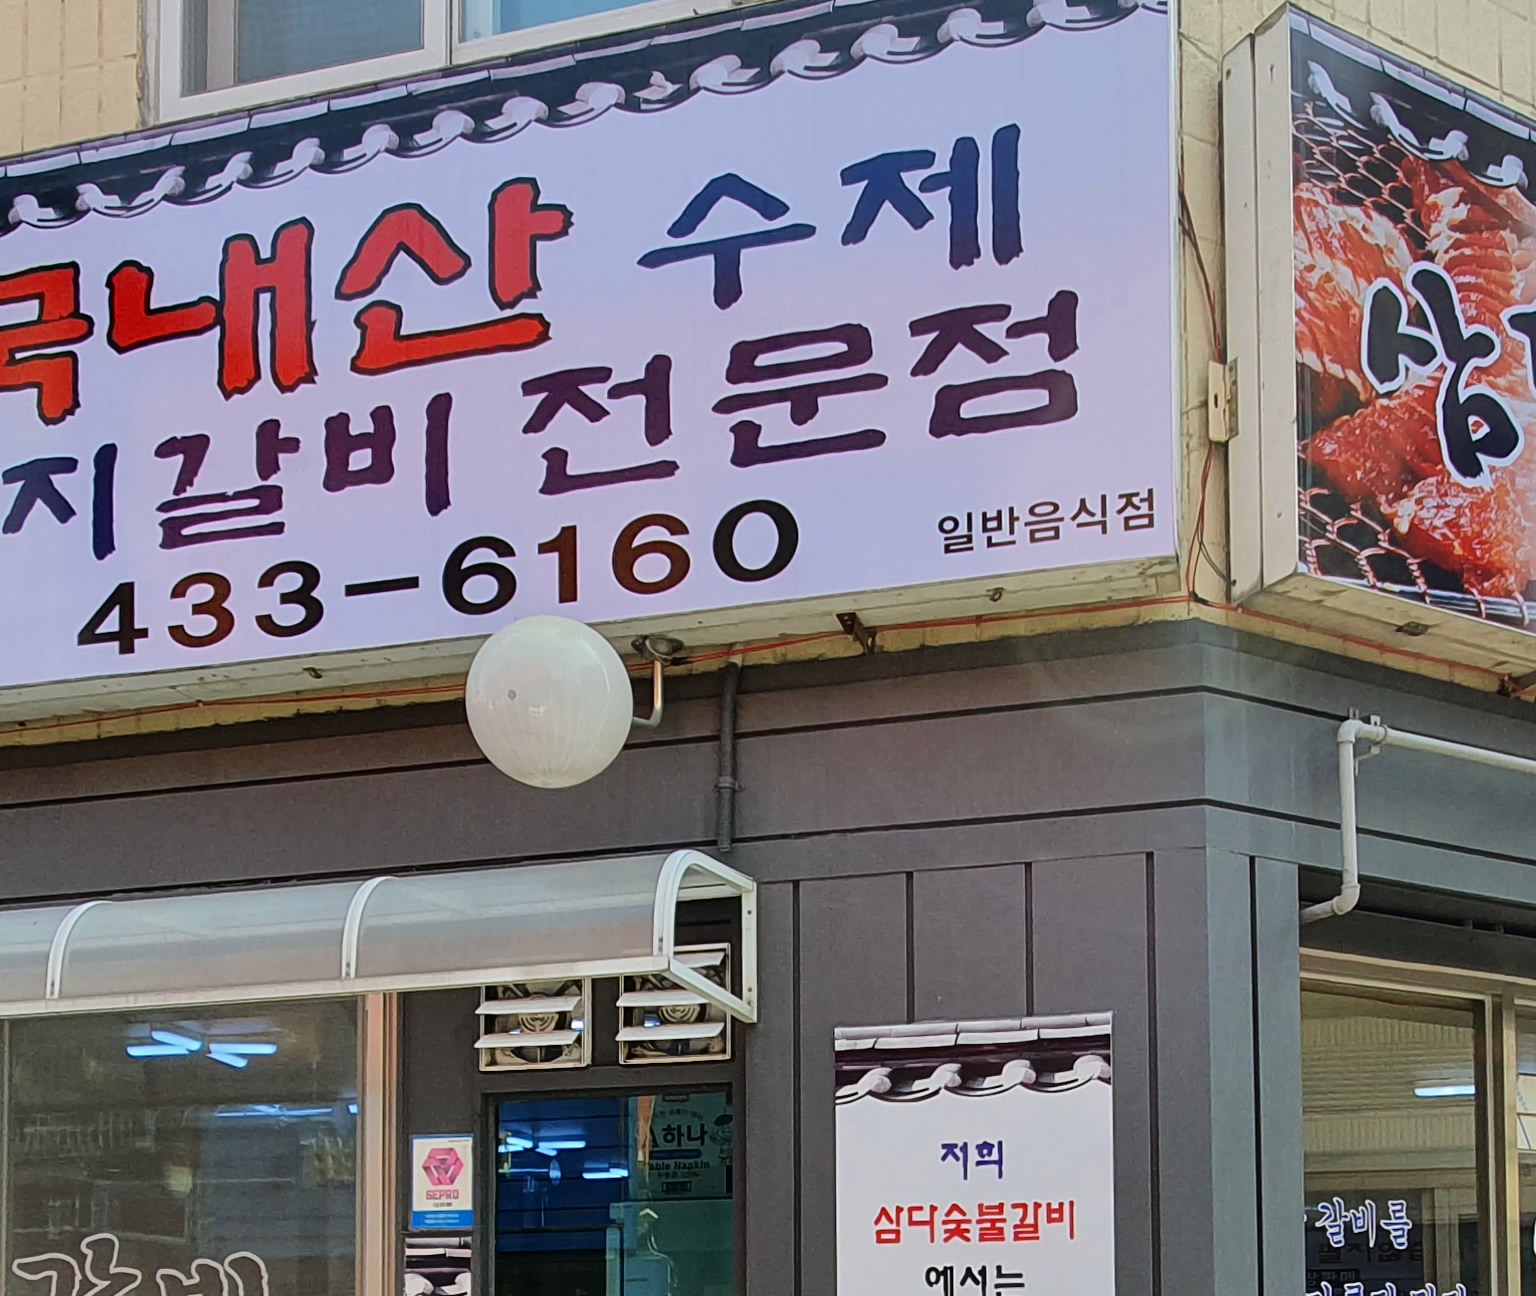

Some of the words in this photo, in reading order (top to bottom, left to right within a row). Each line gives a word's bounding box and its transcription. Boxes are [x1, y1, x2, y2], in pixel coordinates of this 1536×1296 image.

[636, 122, 1024, 309] 수제
[521, 290, 1080, 495] 전문점
[936, 488, 1157, 554] 일반음식점
[76, 499, 800, 655] 433-6160
[939, 1139, 1005, 1181] 저희
[425, 1189, 460, 1200] SEPRO
[1314, 1196, 1412, 1249] 갈비를
